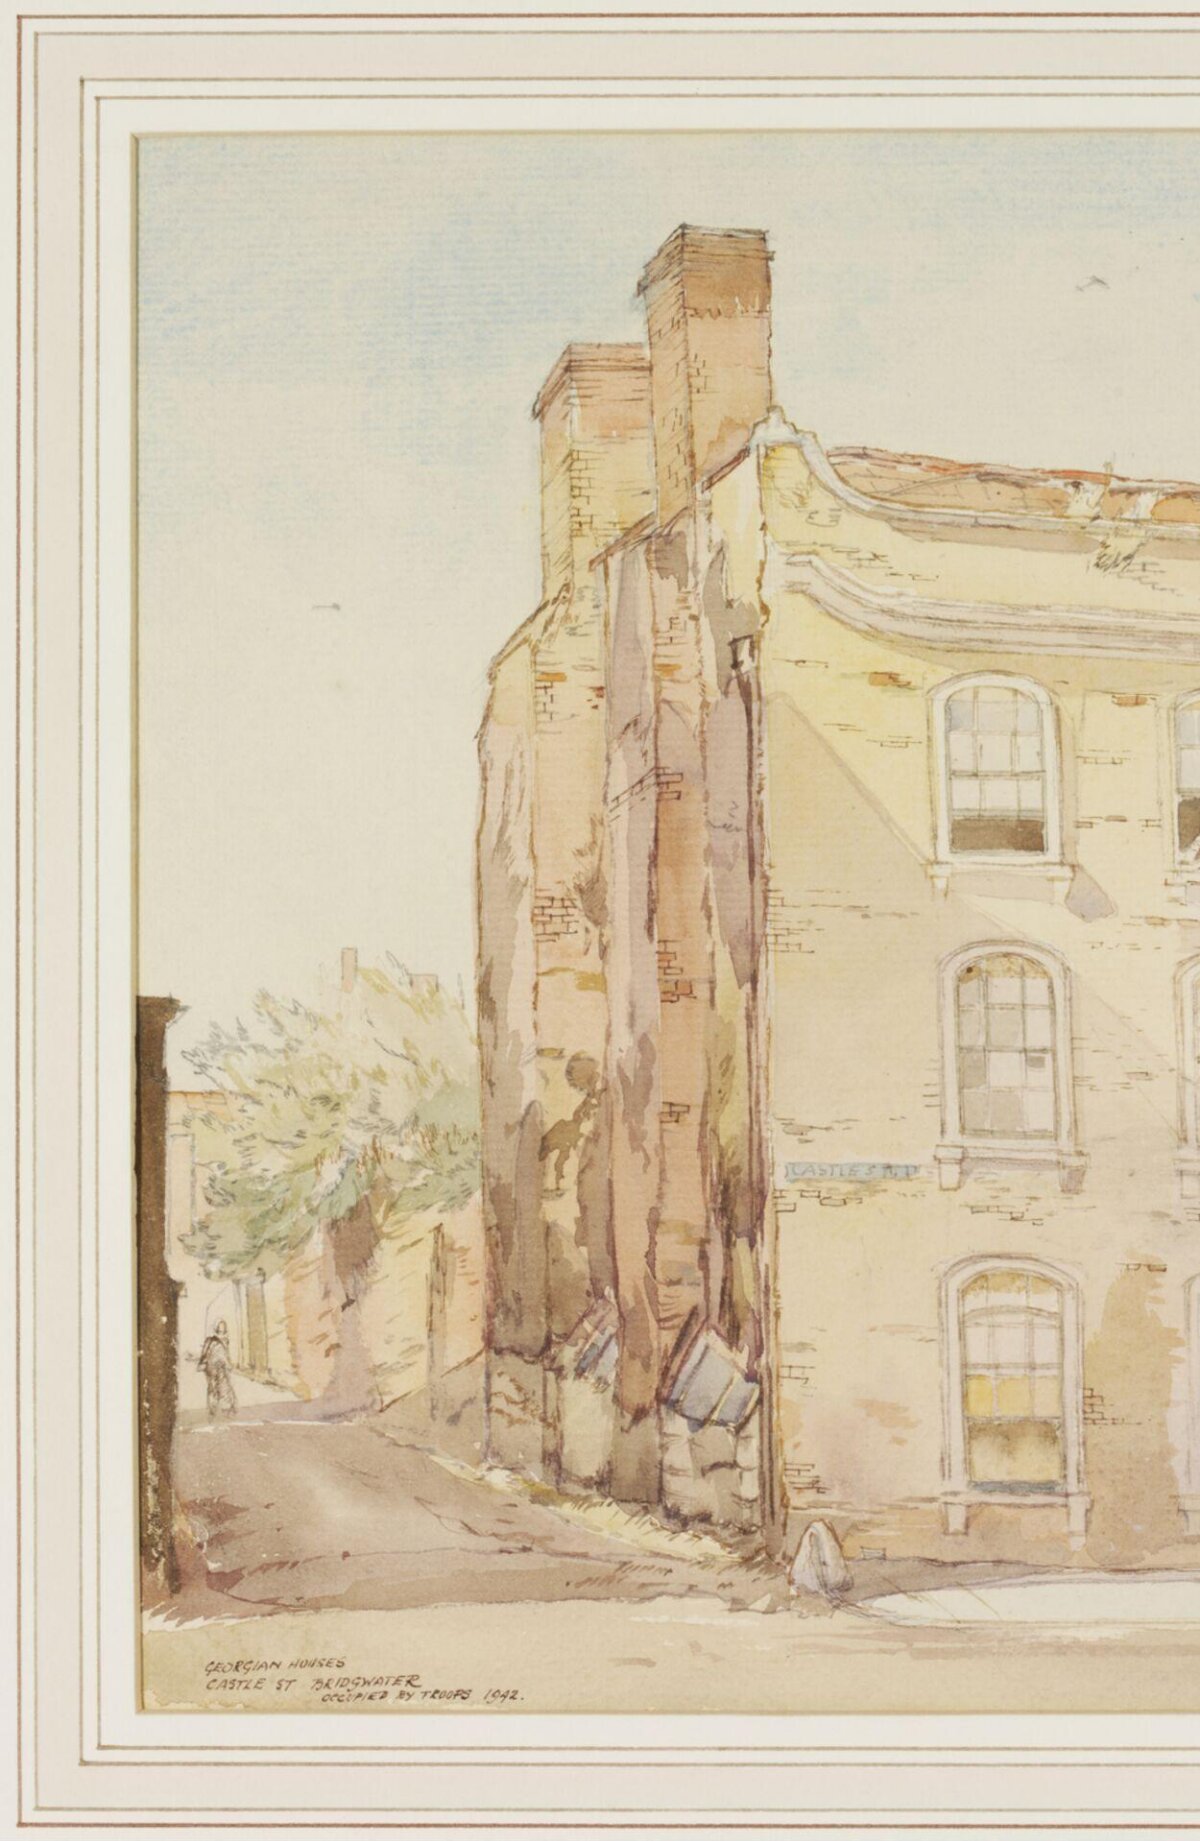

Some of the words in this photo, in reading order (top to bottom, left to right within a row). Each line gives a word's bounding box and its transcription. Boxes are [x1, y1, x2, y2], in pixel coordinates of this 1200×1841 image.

[205, 1659, 282, 1676] GEORGIAN
[288, 1657, 346, 1670] HOUSES
[206, 1677, 266, 1691] CASTLE
[275, 1678, 297, 1691] ST
[311, 1674, 423, 1692] BRIDGWATER
[321, 1689, 388, 1703] OCCUPIED
[398, 1690, 413, 1701] BY
[420, 1689, 472, 1701] TROOPS
